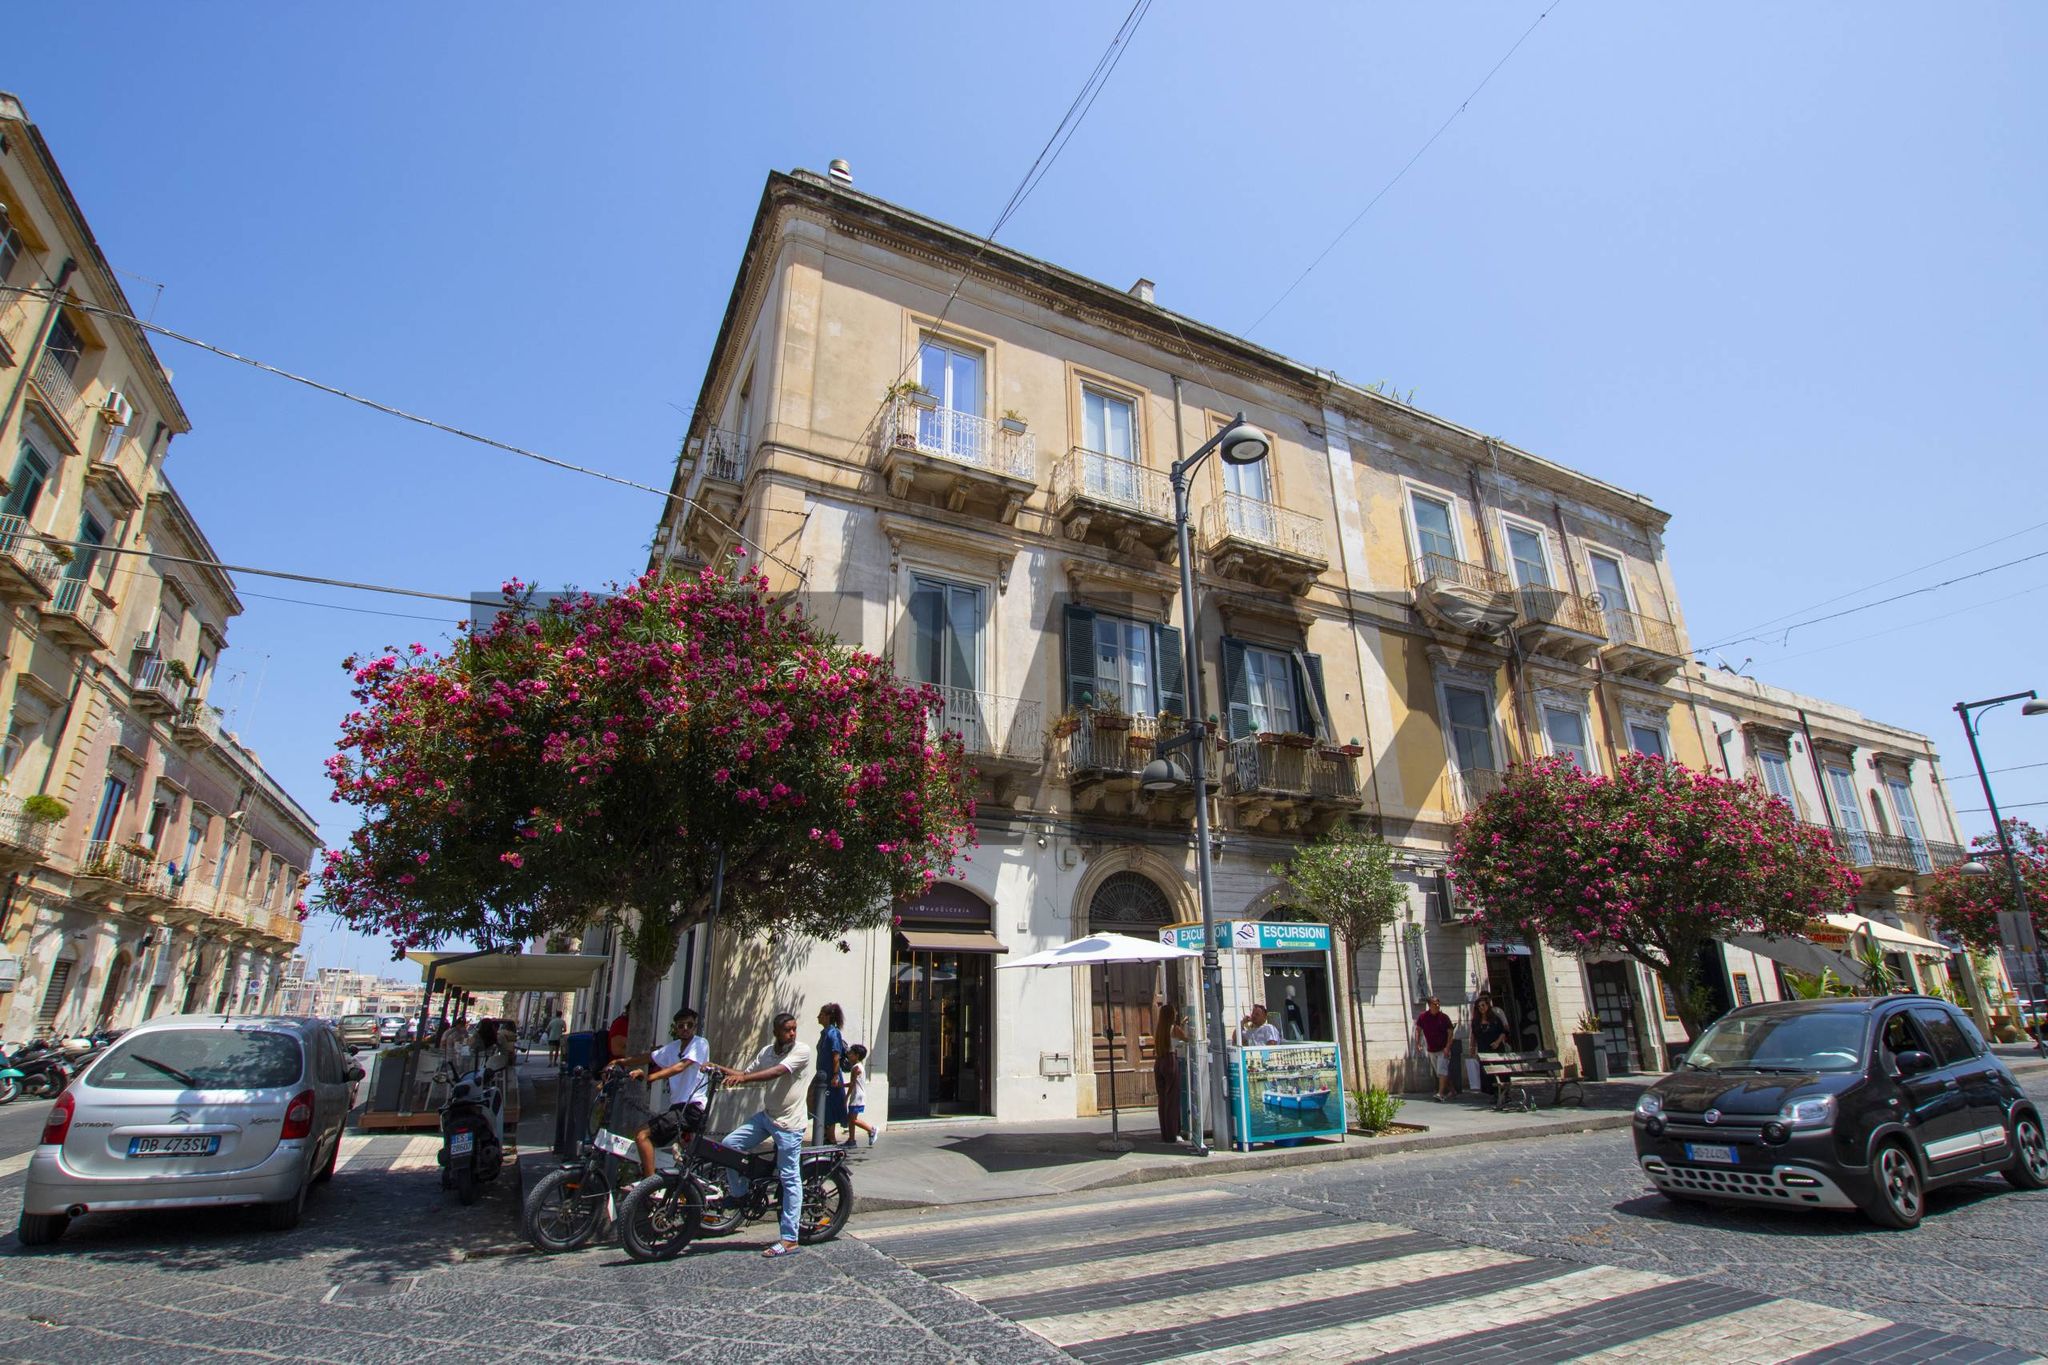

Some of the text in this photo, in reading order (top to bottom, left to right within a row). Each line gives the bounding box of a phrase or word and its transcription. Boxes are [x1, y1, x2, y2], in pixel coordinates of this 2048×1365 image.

[1181, 926, 1227, 941] EXCUON
[1263, 926, 1326, 939] ESCURSIONI
[139, 1137, 210, 1152] DB 473SW
